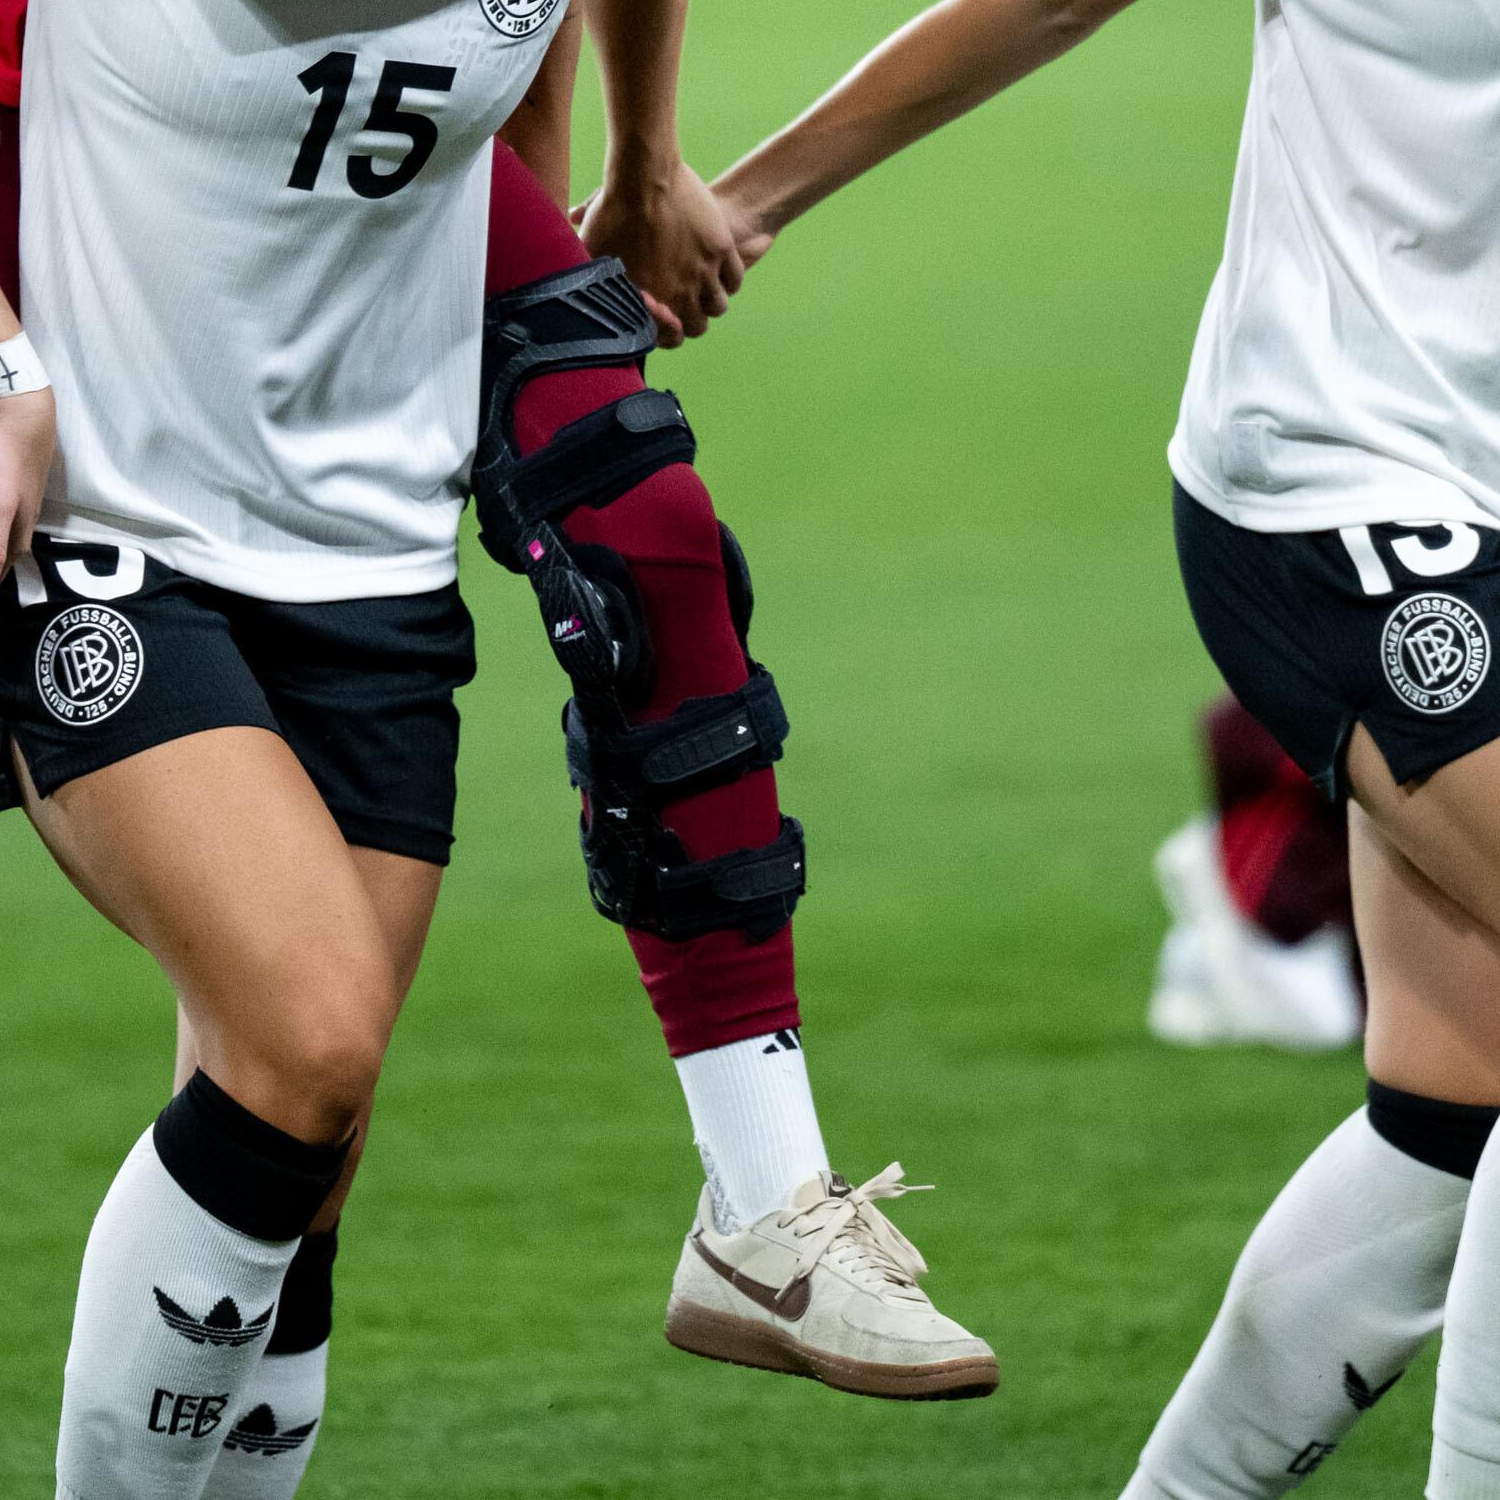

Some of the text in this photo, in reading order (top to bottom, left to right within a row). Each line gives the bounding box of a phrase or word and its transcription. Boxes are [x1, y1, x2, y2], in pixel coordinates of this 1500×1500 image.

[287, 52, 456, 199] 15
[40, 609, 137, 718] DEUTSCHER FUSSBALL-BUND
[1387, 599, 1484, 706] DEUTSCHER FUSSBALL-BUND
[85, 700, 108, 719] 125
